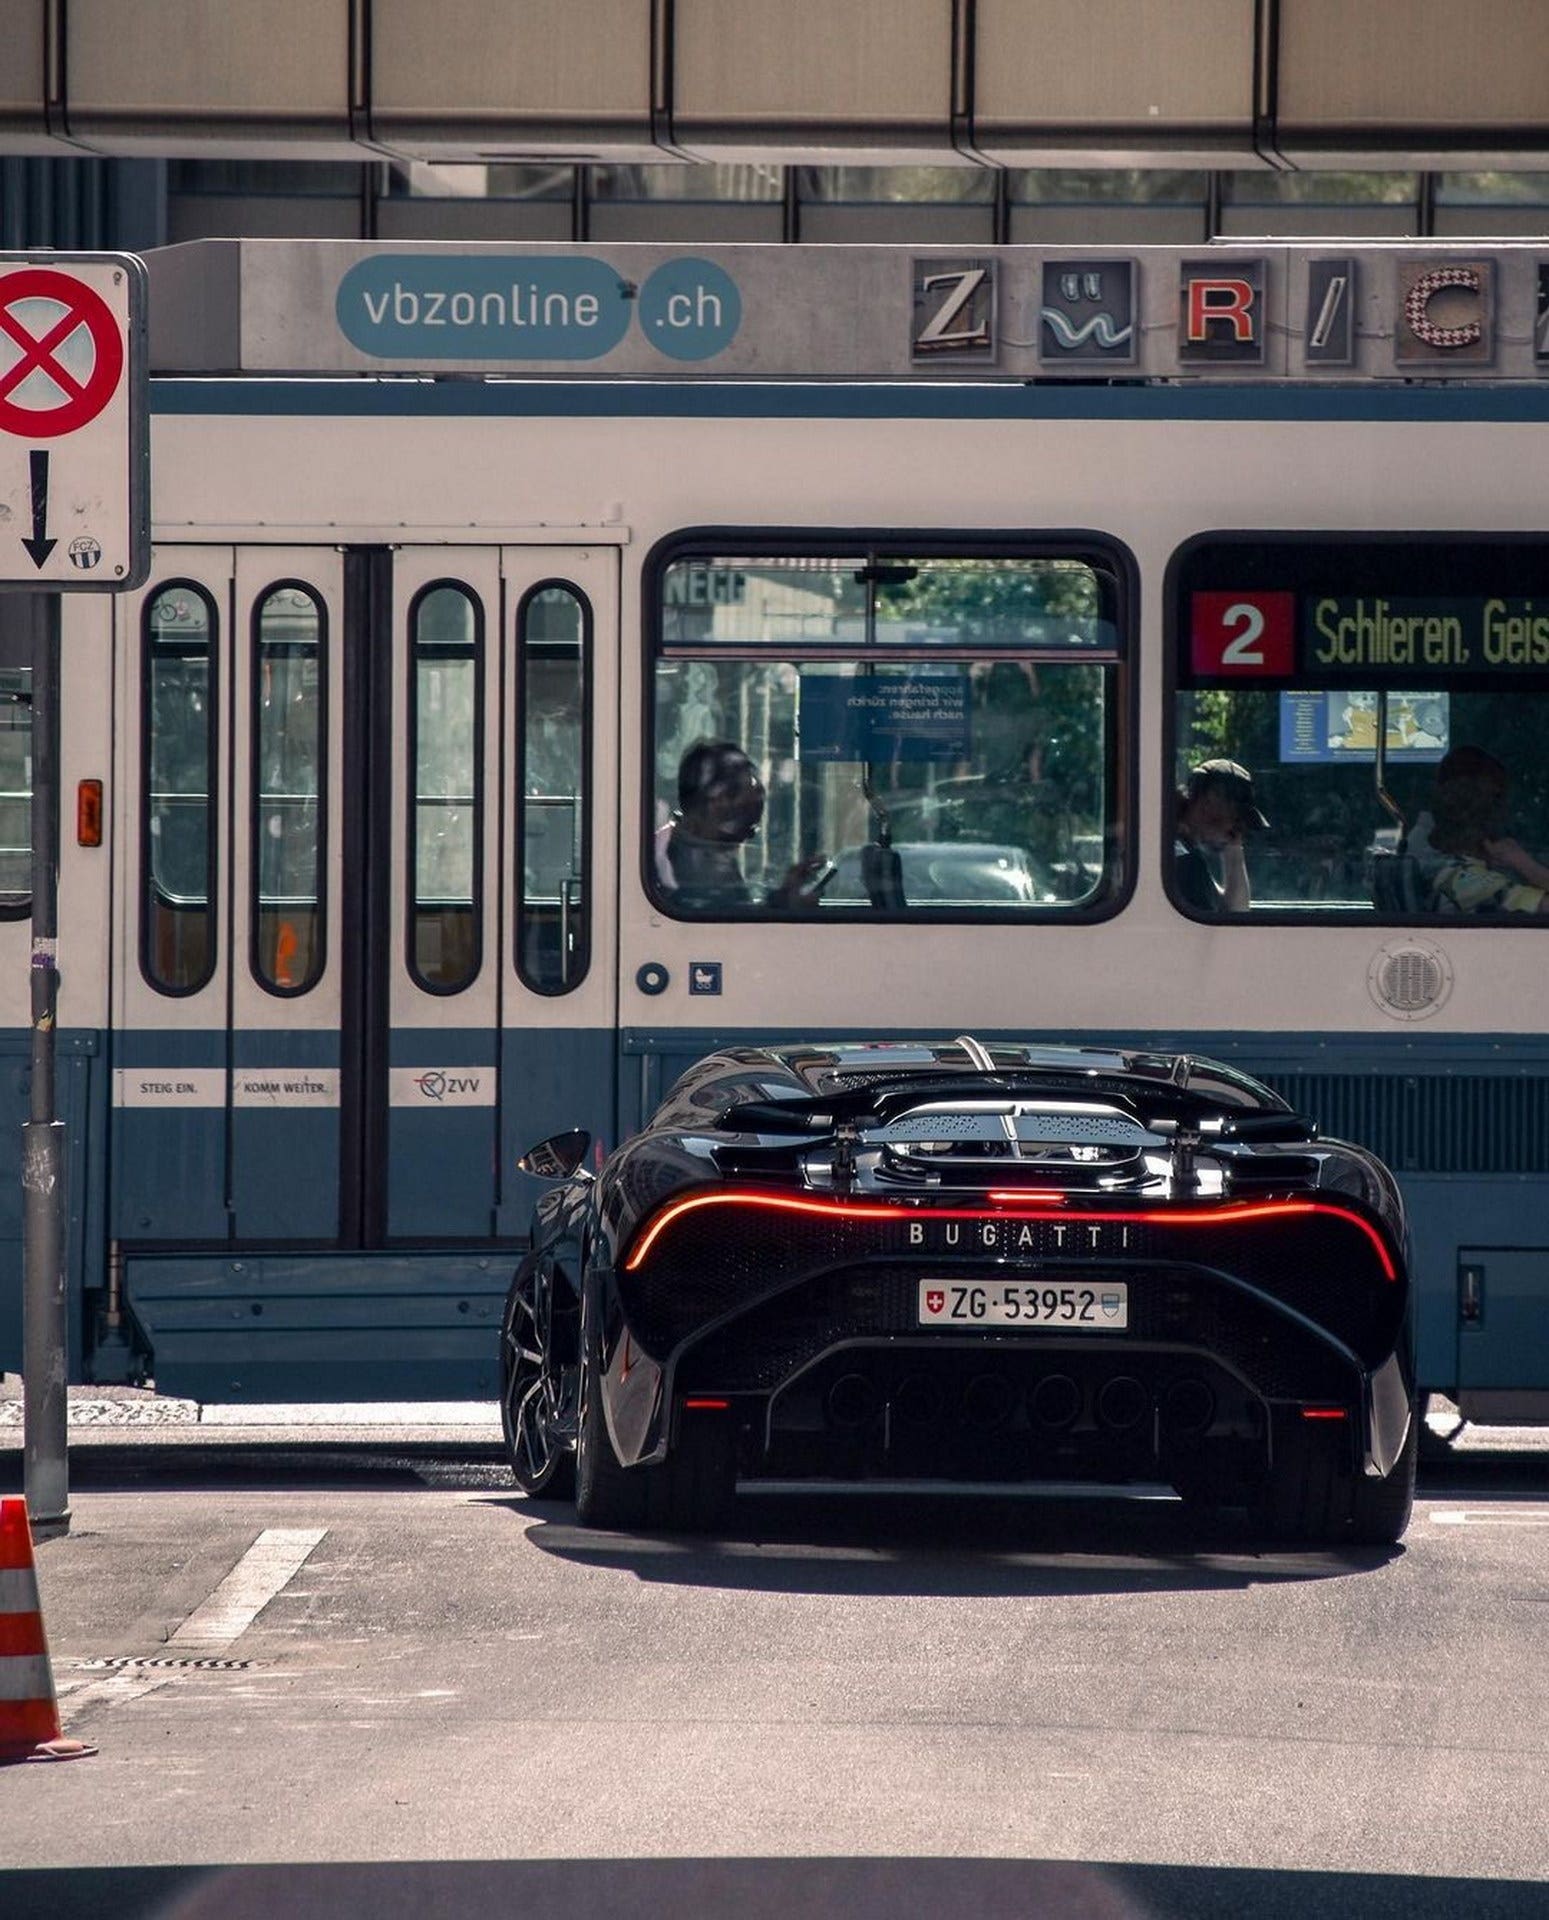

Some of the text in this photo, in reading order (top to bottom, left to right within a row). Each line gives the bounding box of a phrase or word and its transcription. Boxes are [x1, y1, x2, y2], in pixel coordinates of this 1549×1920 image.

[363, 282, 723, 328] vbzonline .ch
[73, 541, 94, 552] FCZ
[1221, 603, 1266, 665] 2
[1315, 598, 1470, 665] Schlieren,
[140, 1083, 198, 1094] STEIG EIN.
[243, 1083, 281, 1094] KOMM
[448, 1079, 480, 1093] ZVV
[909, 1223, 1128, 1248] BUGATTI
